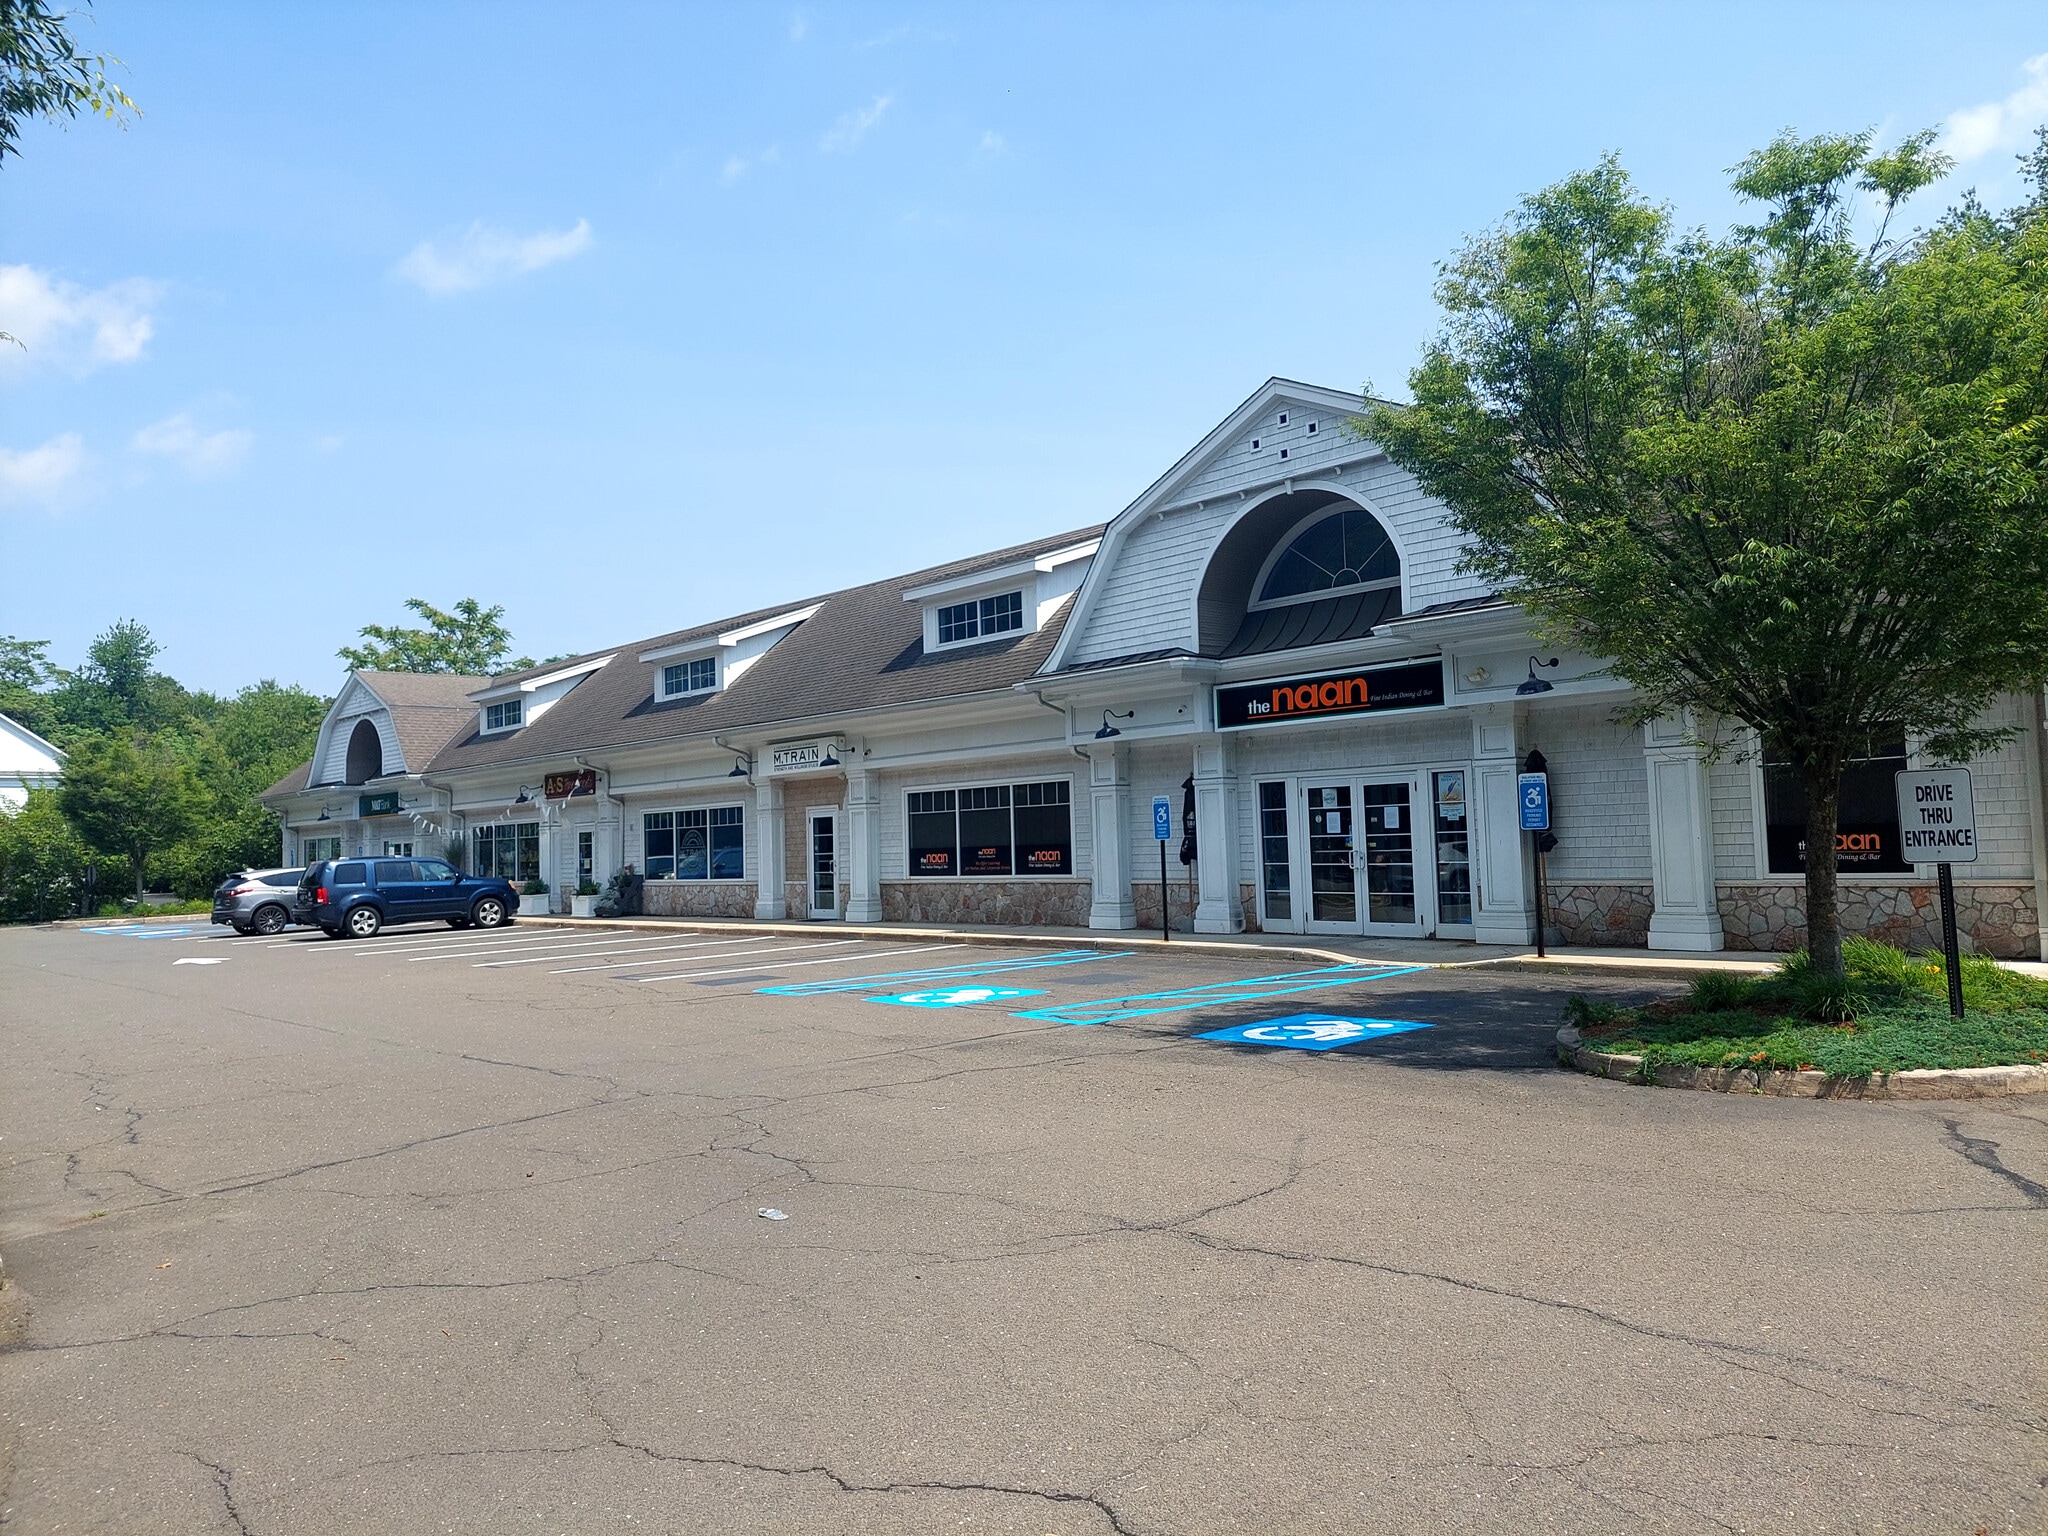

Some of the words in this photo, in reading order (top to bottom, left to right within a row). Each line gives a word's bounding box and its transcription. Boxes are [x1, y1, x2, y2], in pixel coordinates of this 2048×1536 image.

[1247, 699, 1270, 715] the
[1272, 677, 1368, 712] naan
[774, 748, 819, 765] M.TRAIN
[1915, 784, 1953, 802] DRIVE
[1920, 807, 1953, 824] THRU
[1835, 833, 1880, 850] aan
[1905, 829, 1972, 847] ENTRANCE
[926, 853, 949, 863] naan
[1035, 850, 1061, 861] naan
[1837, 853, 1859, 862] Dining
